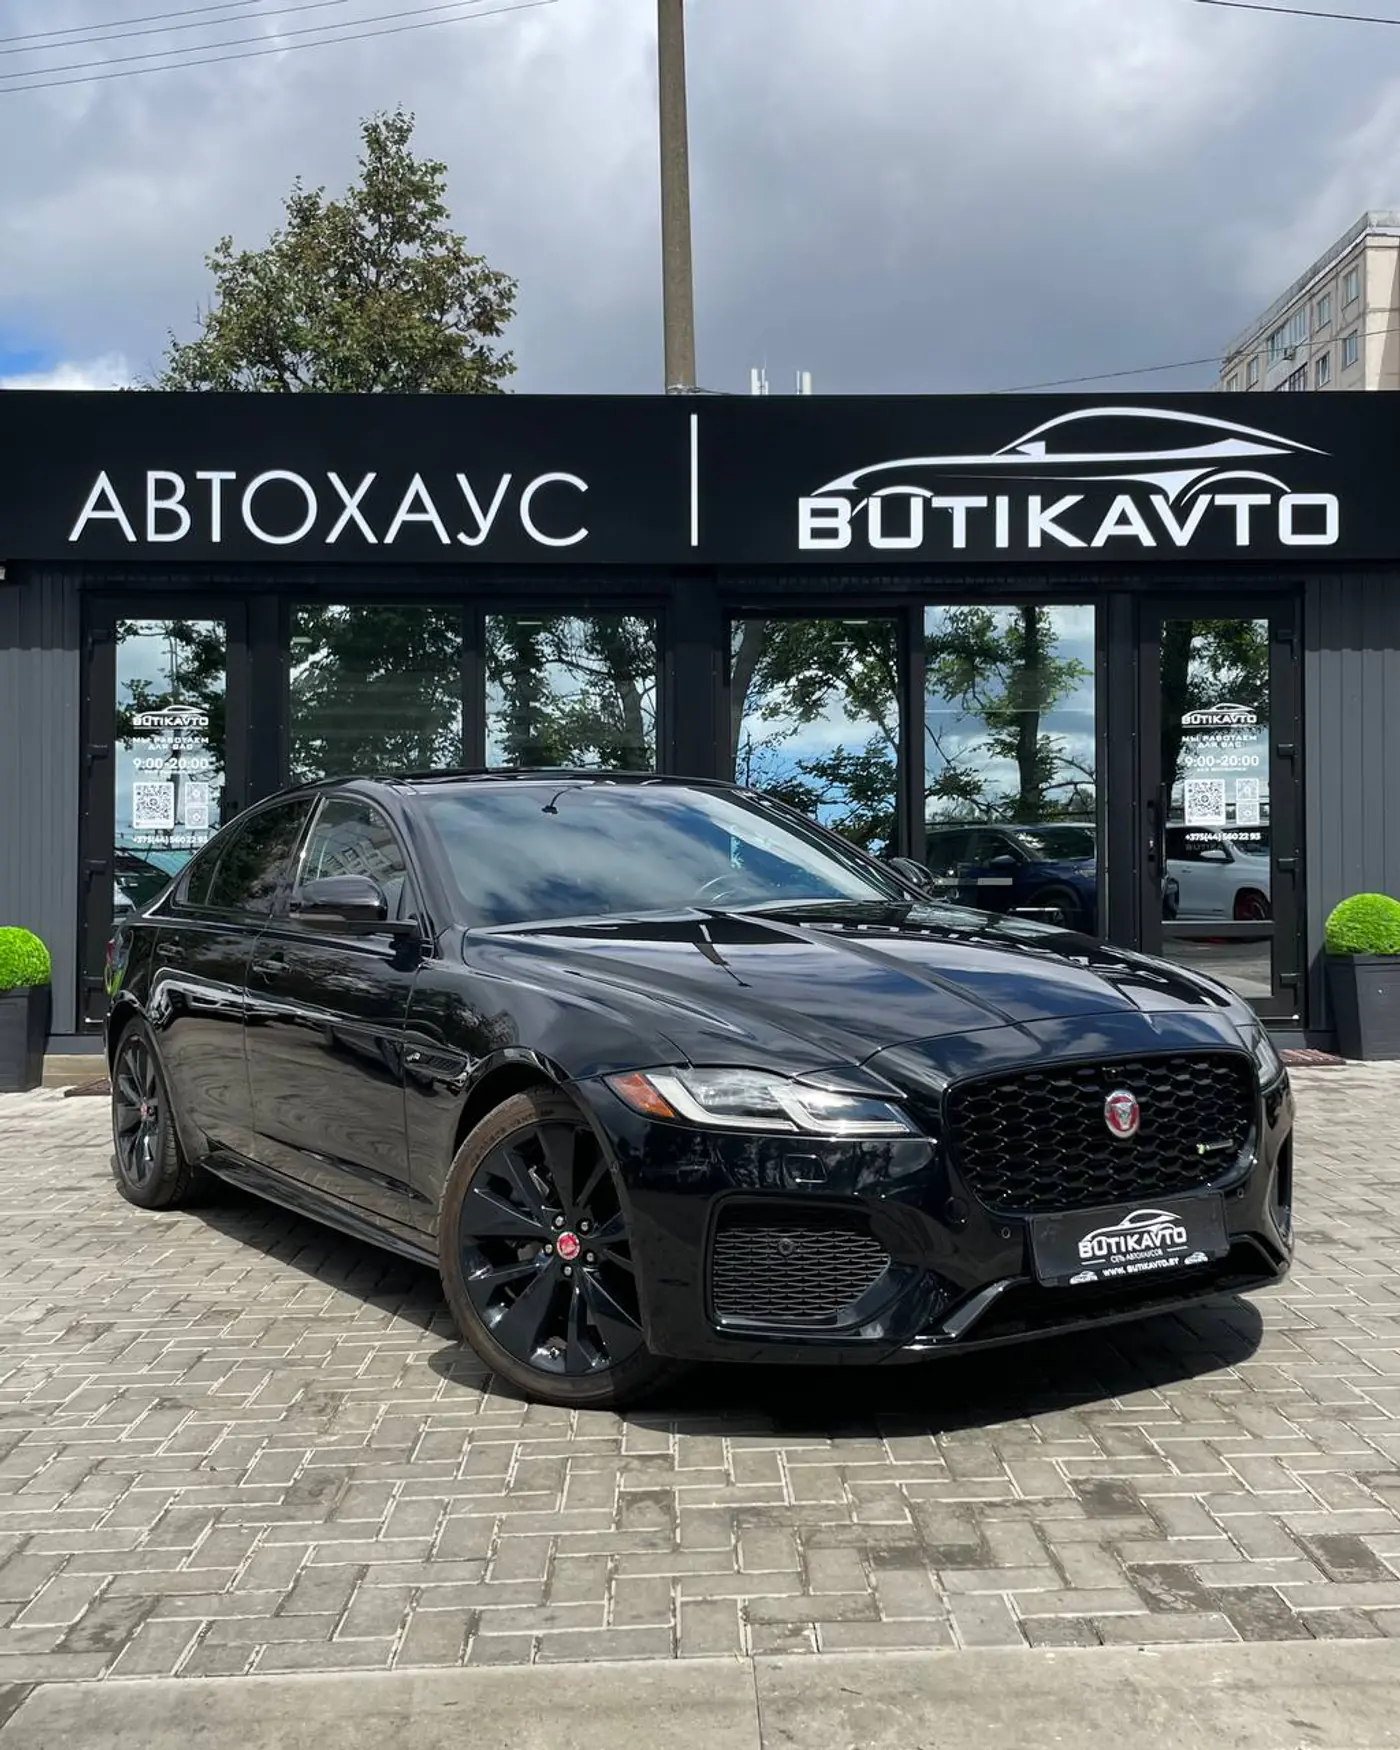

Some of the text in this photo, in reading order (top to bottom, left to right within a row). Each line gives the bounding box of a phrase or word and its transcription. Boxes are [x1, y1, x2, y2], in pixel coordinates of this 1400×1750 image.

[68, 470, 590, 547] АВТОХАУС
[797, 491, 1339, 550] BUTIKAVTO
[132, 715, 209, 726] BUTIKAVTO
[1181, 714, 1257, 724] BUTIKAVTO
[132, 757, 209, 769] 9:00-20:00
[1184, 755, 1260, 767] 9:00-20:00
[1078, 1226, 1187, 1258] BUTIKAVTO
